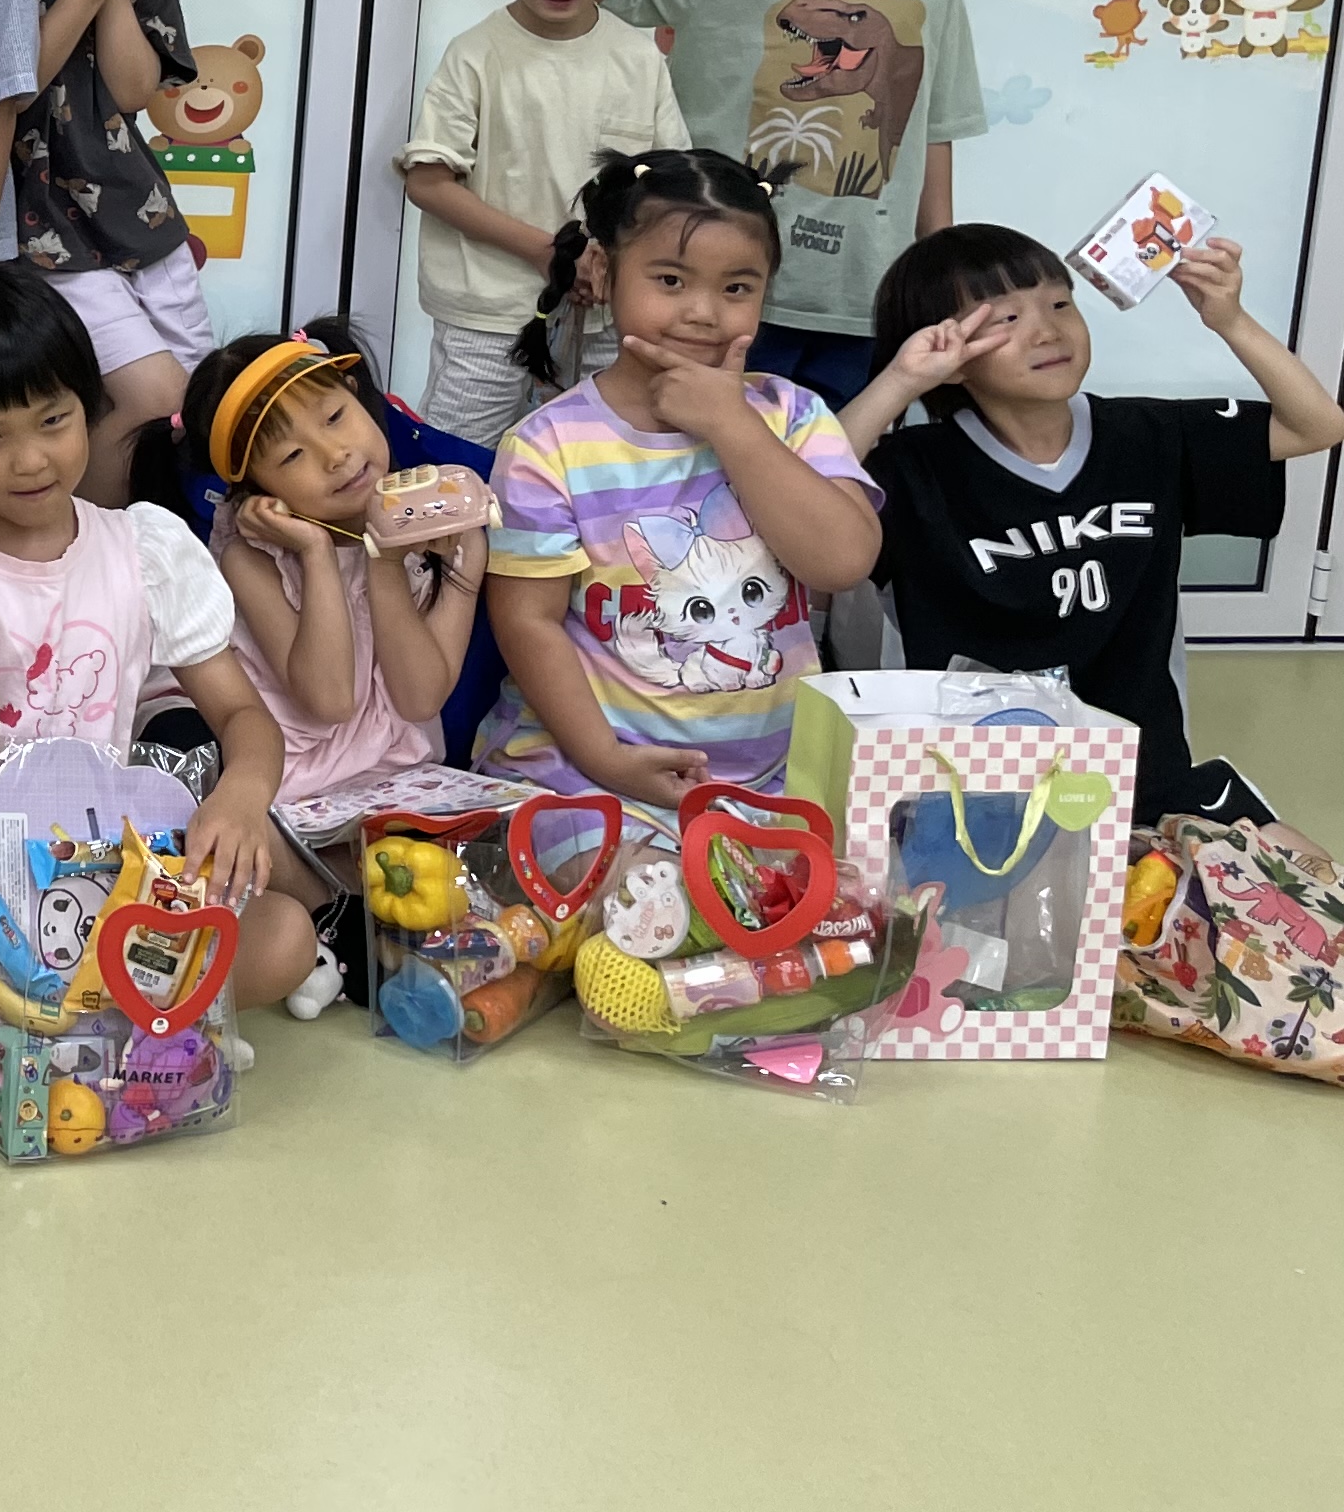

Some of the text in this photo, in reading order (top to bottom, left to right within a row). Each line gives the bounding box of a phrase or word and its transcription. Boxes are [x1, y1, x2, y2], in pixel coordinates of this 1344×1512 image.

[969, 502, 1156, 575] NIKE
[1052, 560, 1111, 617] 90
[112, 1068, 185, 1087] MARKET
